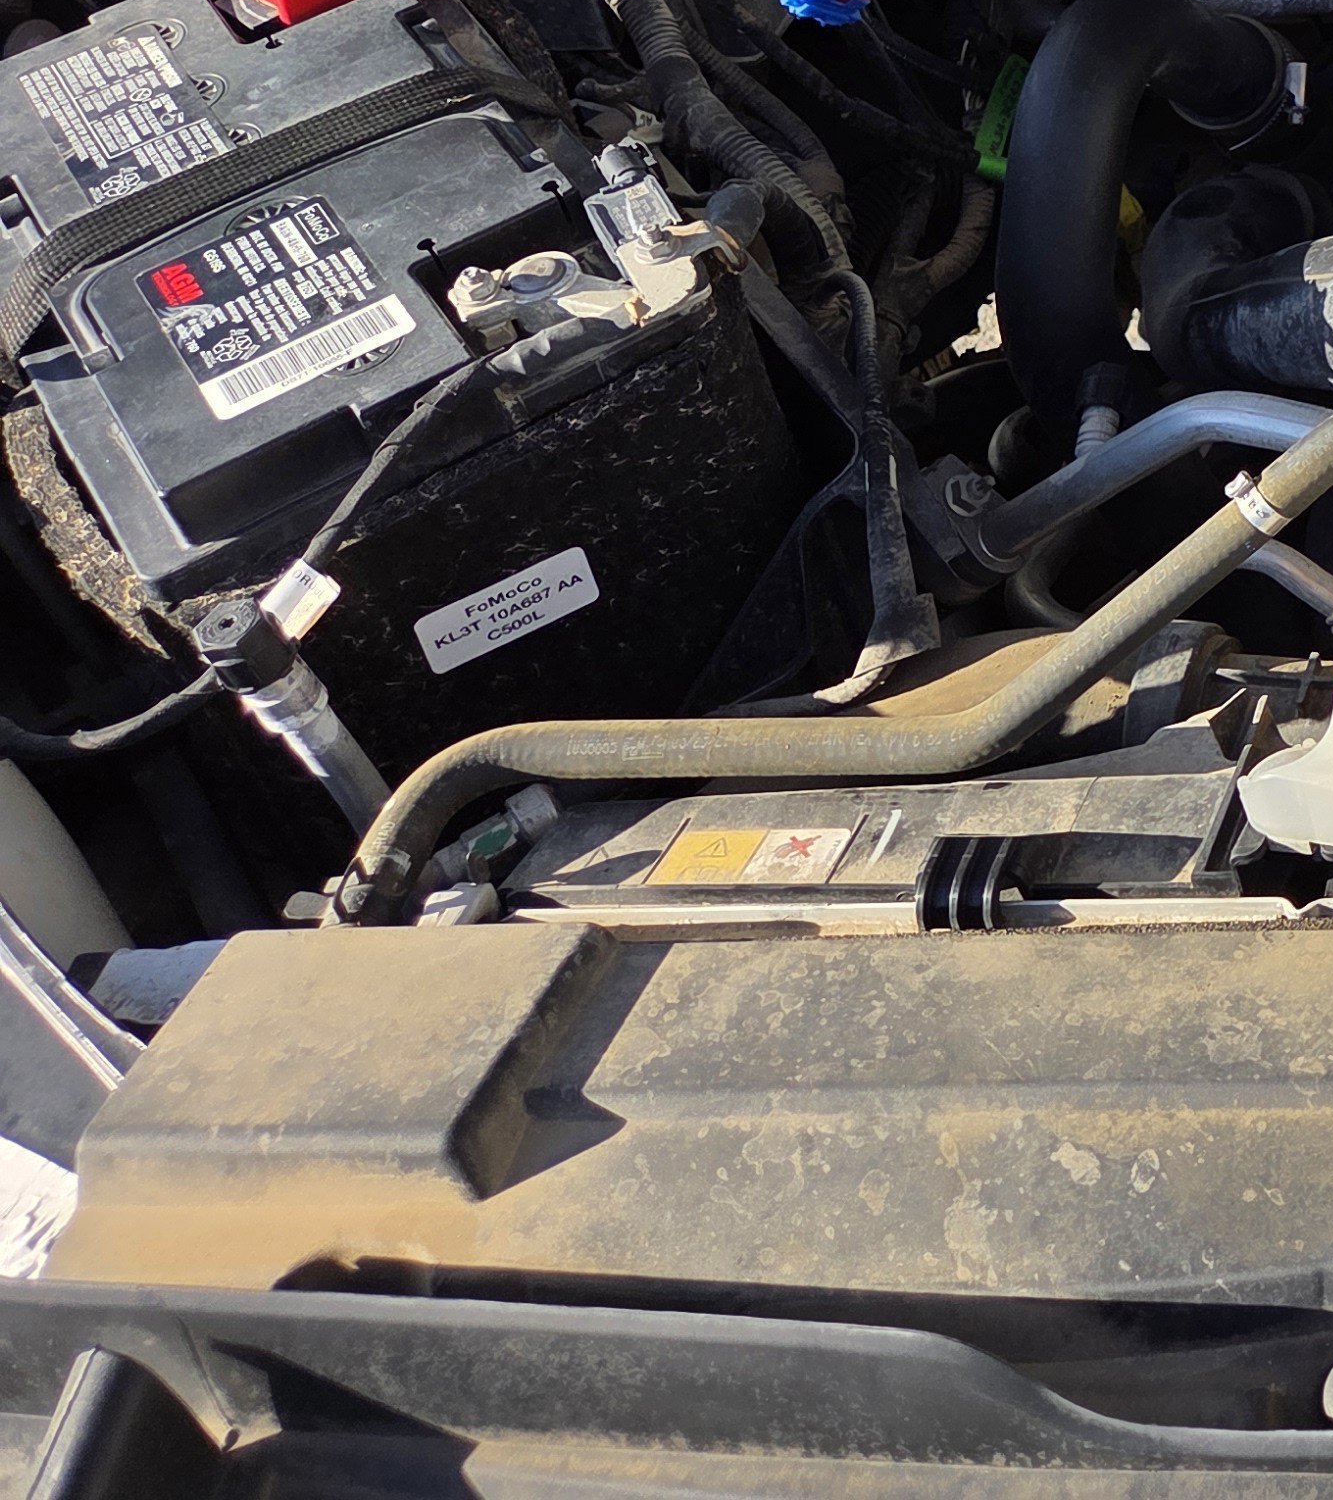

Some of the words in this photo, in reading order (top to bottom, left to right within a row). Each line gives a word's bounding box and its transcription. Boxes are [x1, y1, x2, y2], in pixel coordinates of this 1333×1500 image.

[300, 206, 331, 242] FoMoCo
[161, 262, 204, 304] AGM
[434, 619, 482, 649] KL3T
[488, 587, 551, 623] 10A687
[558, 574, 583, 592] AA
[464, 577, 542, 618] FoMoCo
[487, 611, 546, 641] C500L
